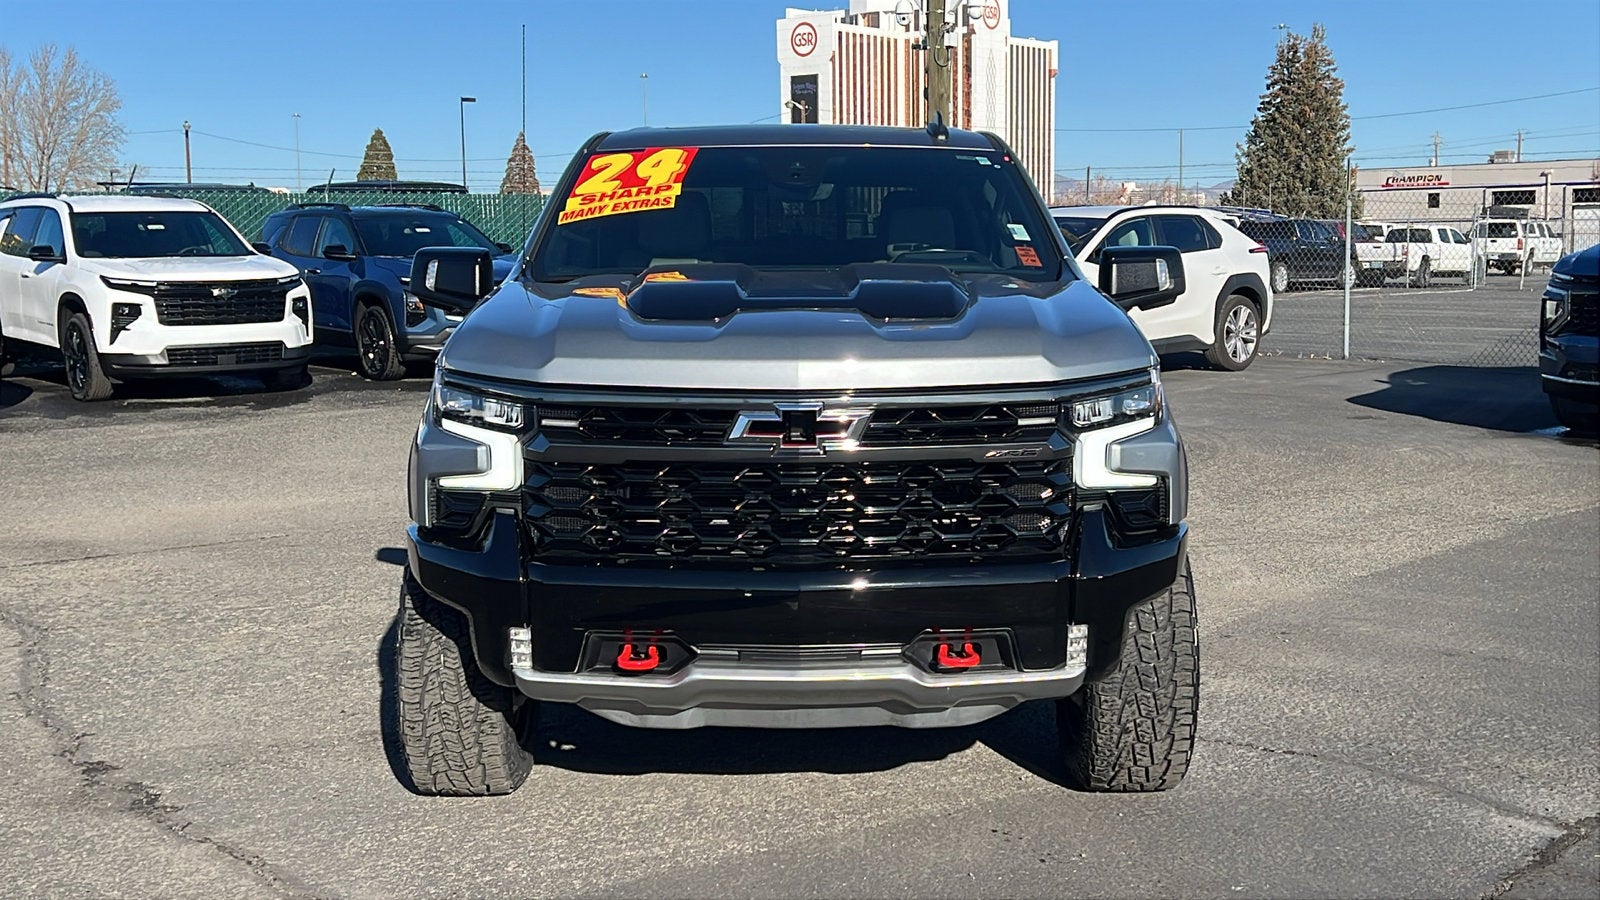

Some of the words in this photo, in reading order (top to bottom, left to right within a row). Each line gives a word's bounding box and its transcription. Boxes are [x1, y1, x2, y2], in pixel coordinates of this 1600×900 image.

[794, 32, 813, 47] GSR
[575, 149, 688, 195] 24
[1385, 174, 1442, 186] CHAMPION
[579, 184, 672, 204] SHARP
[560, 204, 608, 222] MANY
[612, 196, 672, 211] EXTRAS
